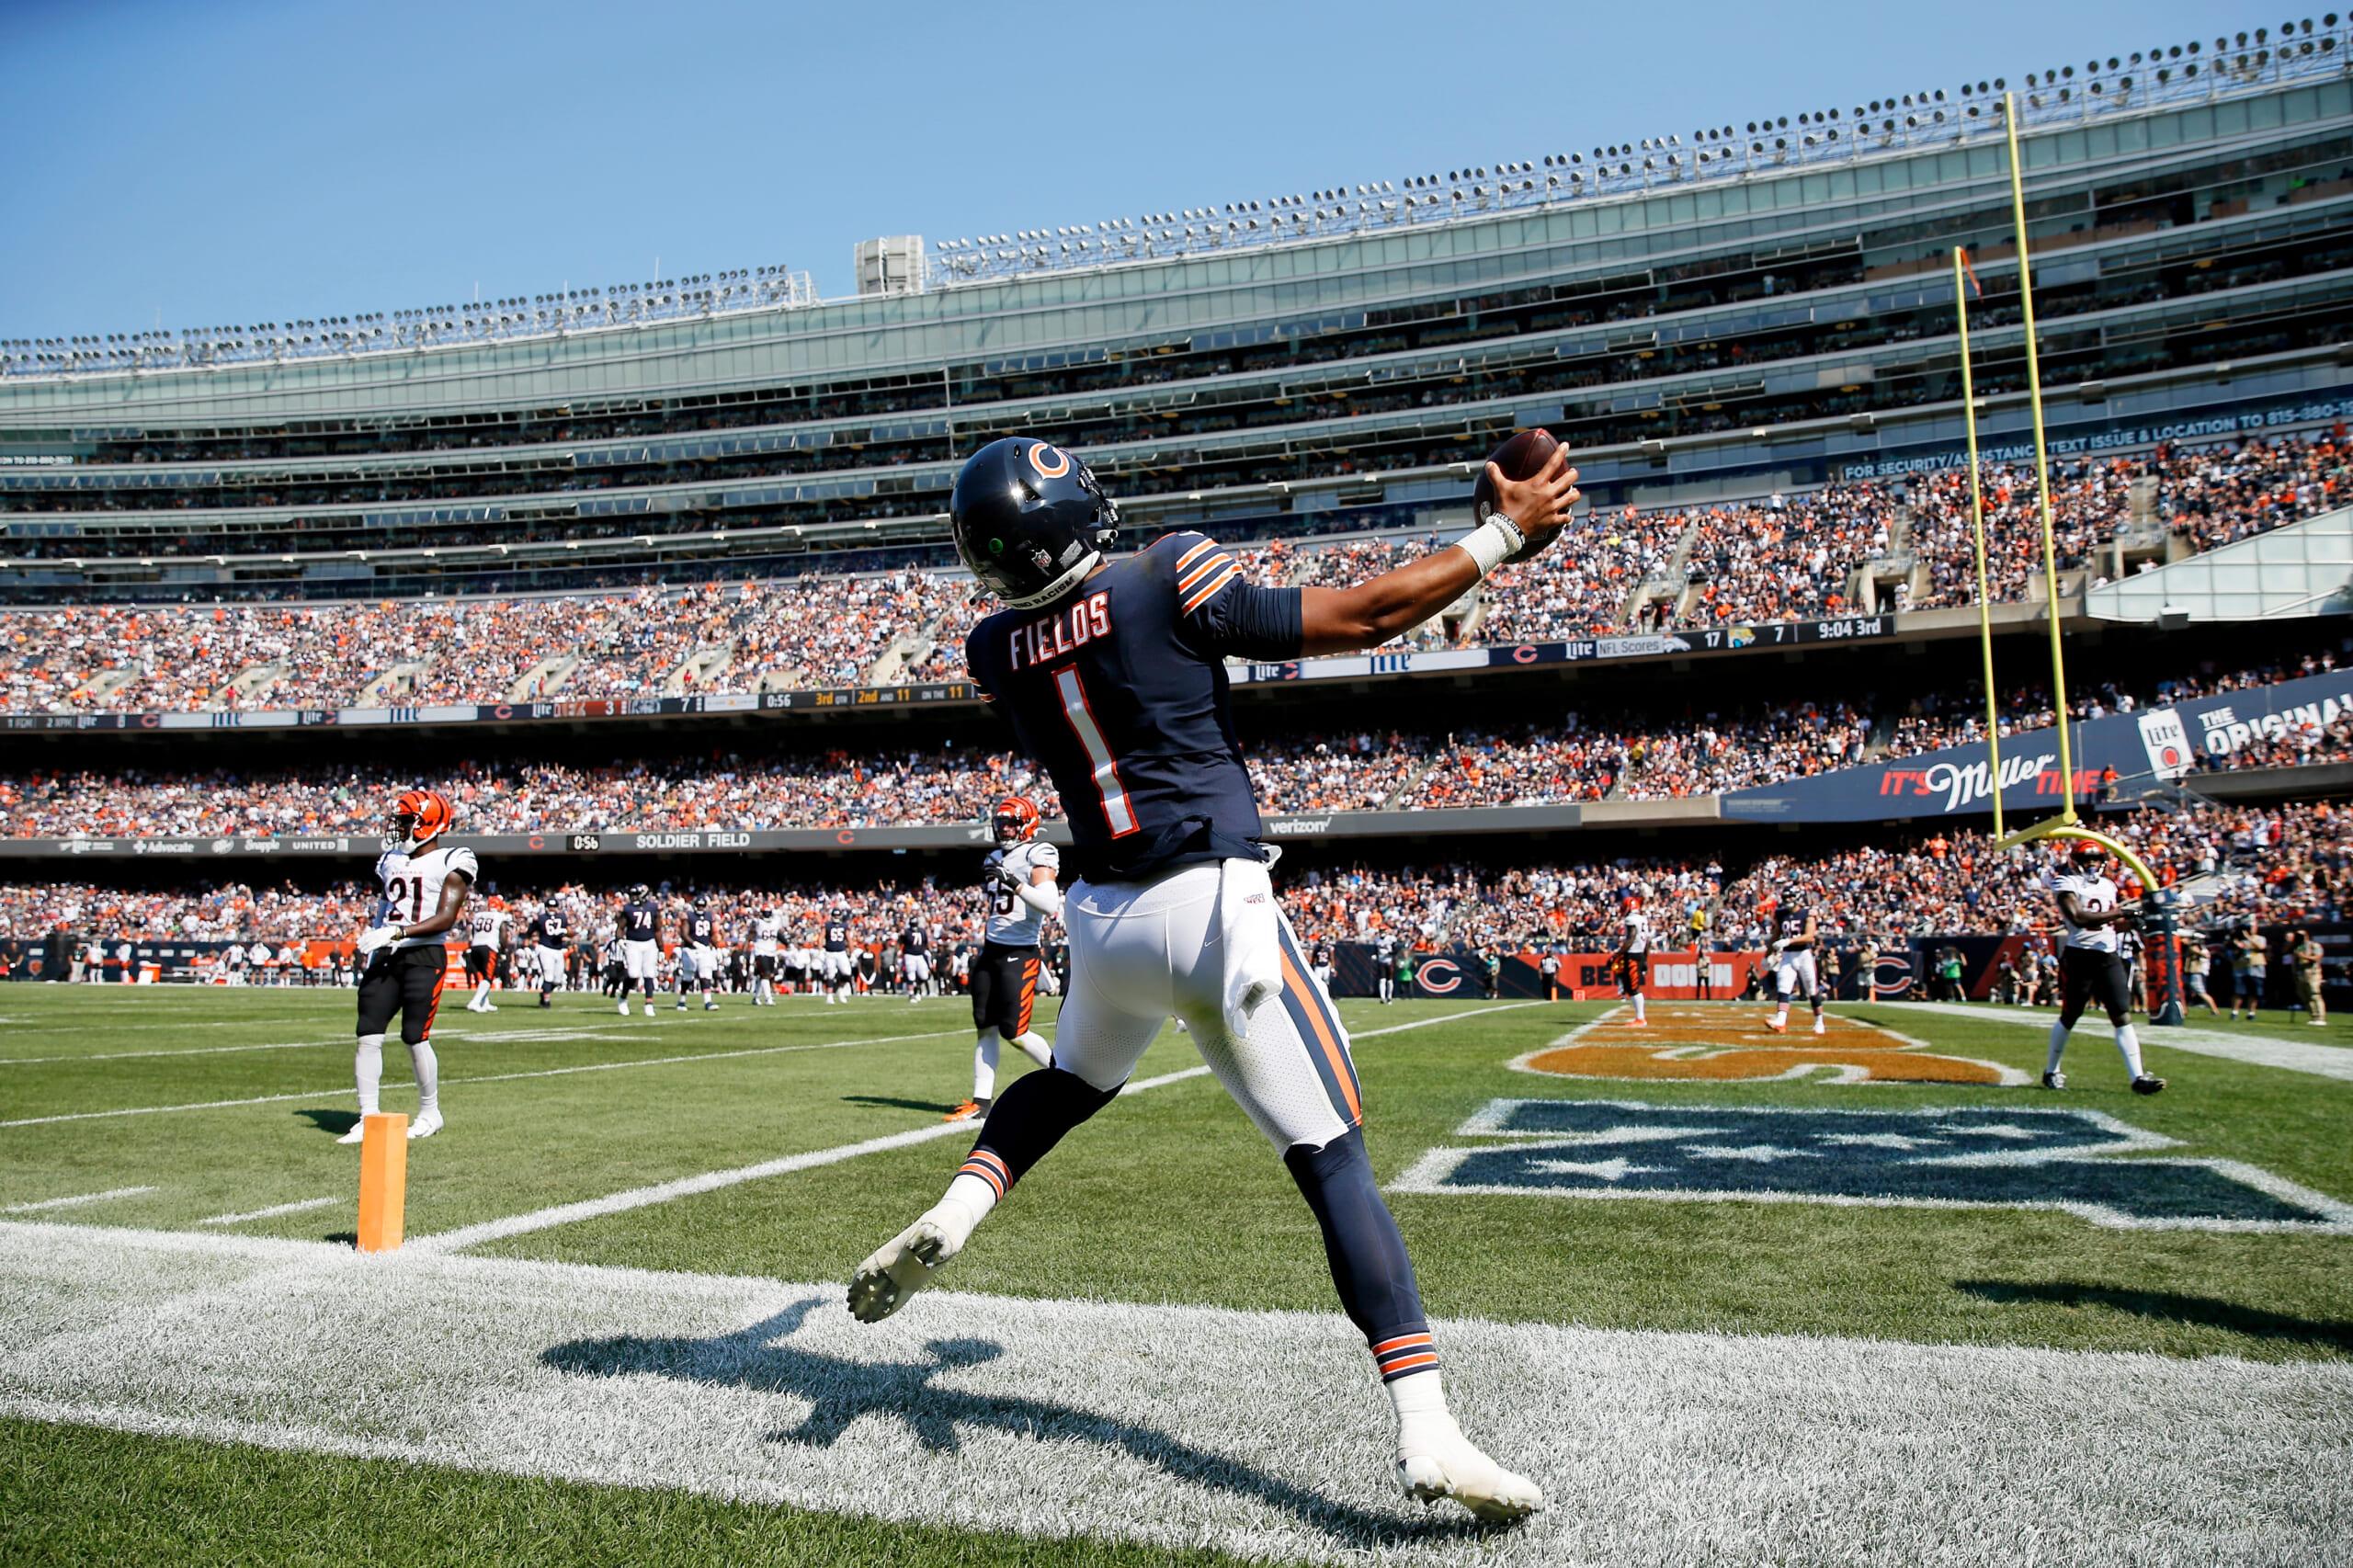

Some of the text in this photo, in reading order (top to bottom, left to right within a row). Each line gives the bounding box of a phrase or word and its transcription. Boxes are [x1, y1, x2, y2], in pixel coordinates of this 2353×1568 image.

[1845, 464, 1874, 479] FOR
[1877, 445, 2037, 475] SECURITY/ASSISTANC
[2048, 437, 2086, 453] TEXT
[2090, 430, 2135, 449] ISSUE
[2139, 429, 2150, 443] &
[2154, 417, 2236, 439] LOCATION
[2239, 415, 2263, 428] TO
[1033, 574, 1074, 605] RACISM
[1010, 590, 1111, 670] FIELDS
[1565, 617, 1881, 660] Lite NFL Scores 17 7 9:04 3rd
[1255, 663, 1279, 680] Lite
[681, 698, 690, 712] 7
[767, 693, 791, 708] 0:56
[815, 692, 834, 706] 3rd
[858, 690, 879, 704] 2nd
[897, 688, 910, 701] 11
[949, 685, 963, 699] 11
[532, 704, 551, 718] Lite
[605, 700, 615, 716] 3
[2198, 706, 2235, 727] THE
[2147, 722, 2178, 746] Lite
[1051, 662, 1140, 839] 1
[1880, 769, 1932, 795] IT'S
[1925, 754, 2056, 812] Miller
[1269, 818, 1325, 834] verizon
[146, 840, 195, 853] Advocate
[244, 839, 279, 853] Snapple
[292, 840, 336, 850] UNITED
[574, 835, 599, 849] 0:56
[636, 833, 751, 848] SOLDIER FIELD
[388, 877, 423, 923] 21
[633, 911, 652, 930] 74
[1781, 920, 1802, 936] 85
[830, 927, 845, 942] 65
